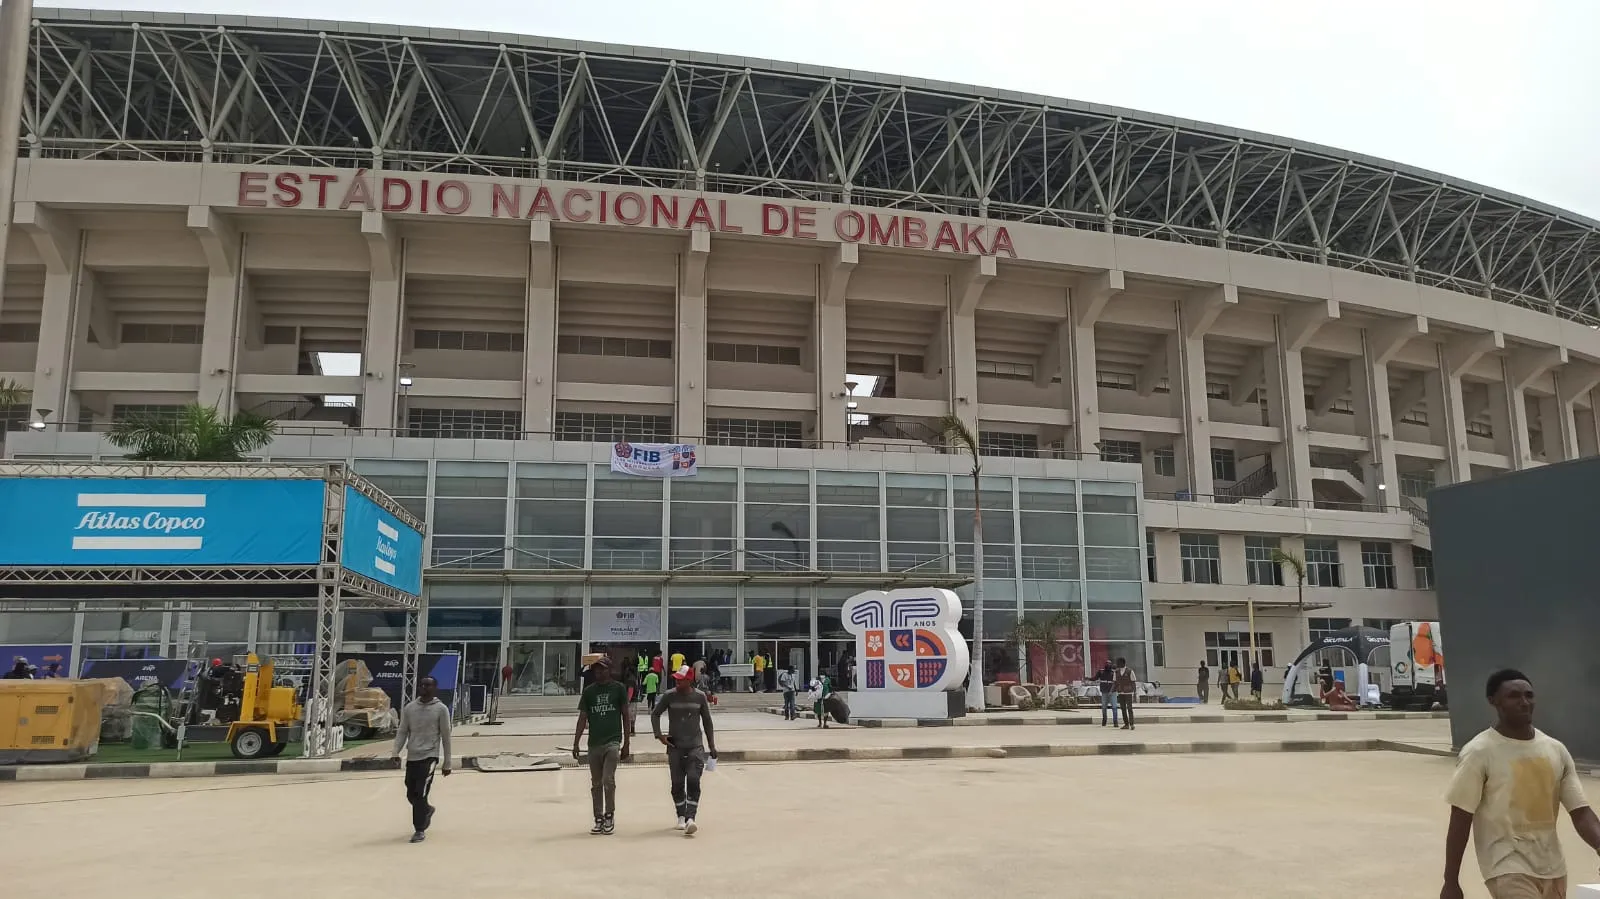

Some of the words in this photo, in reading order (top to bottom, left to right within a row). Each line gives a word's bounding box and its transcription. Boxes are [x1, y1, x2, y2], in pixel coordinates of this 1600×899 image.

[238, 168, 471, 215] ESTÁDIO
[491, 182, 742, 234] NACIONAL
[762, 203, 817, 239] DE
[835, 209, 1017, 259] OMBAKA
[633, 448, 660, 462] FIB
[74, 511, 141, 530] Atlas
[142, 511, 205, 533] Copco
[594, 704, 616, 713] WILL
